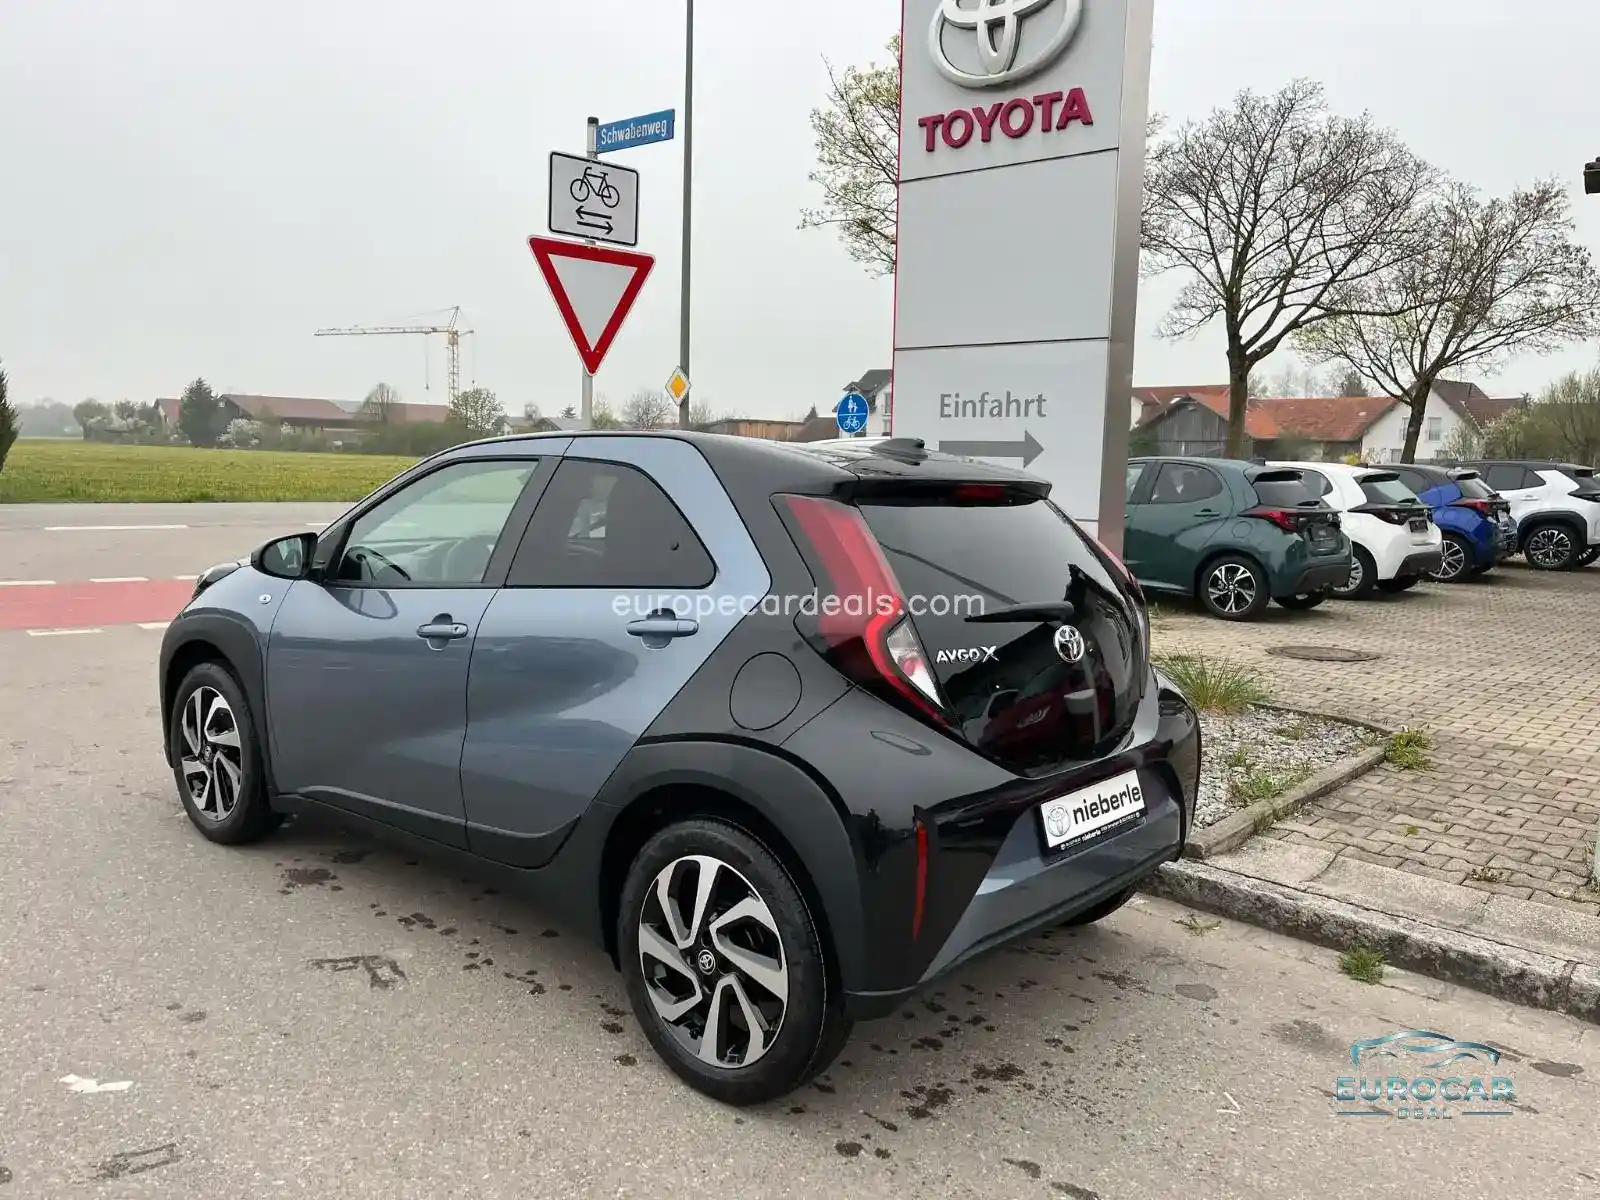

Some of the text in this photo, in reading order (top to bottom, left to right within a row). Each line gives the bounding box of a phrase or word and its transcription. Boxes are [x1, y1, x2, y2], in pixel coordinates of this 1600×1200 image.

[601, 119, 667, 145] Schwabenweg
[918, 87, 1093, 152] TOYOTA
[939, 389, 1047, 418] Einfahrt
[1072, 784, 1141, 824] nieberle
